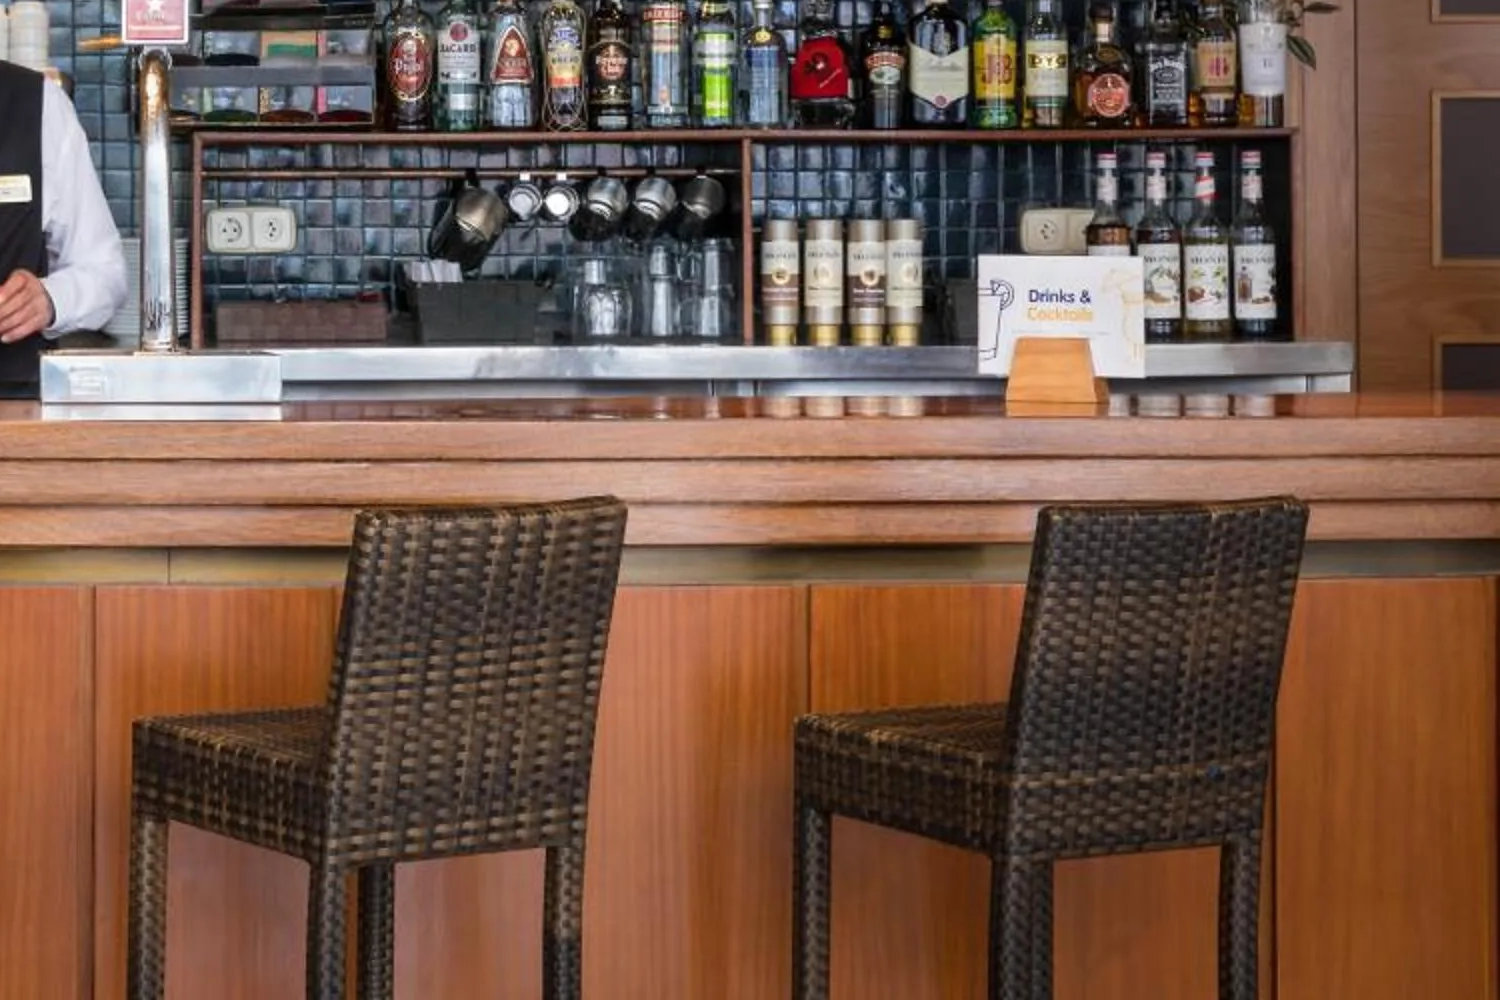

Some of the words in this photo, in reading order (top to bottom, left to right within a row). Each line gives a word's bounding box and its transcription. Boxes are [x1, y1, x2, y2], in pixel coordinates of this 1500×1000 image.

[1028, 289, 1075, 303] Drinks
[1079, 289, 1091, 303] &
[1027, 307, 1093, 321] Cocktails
